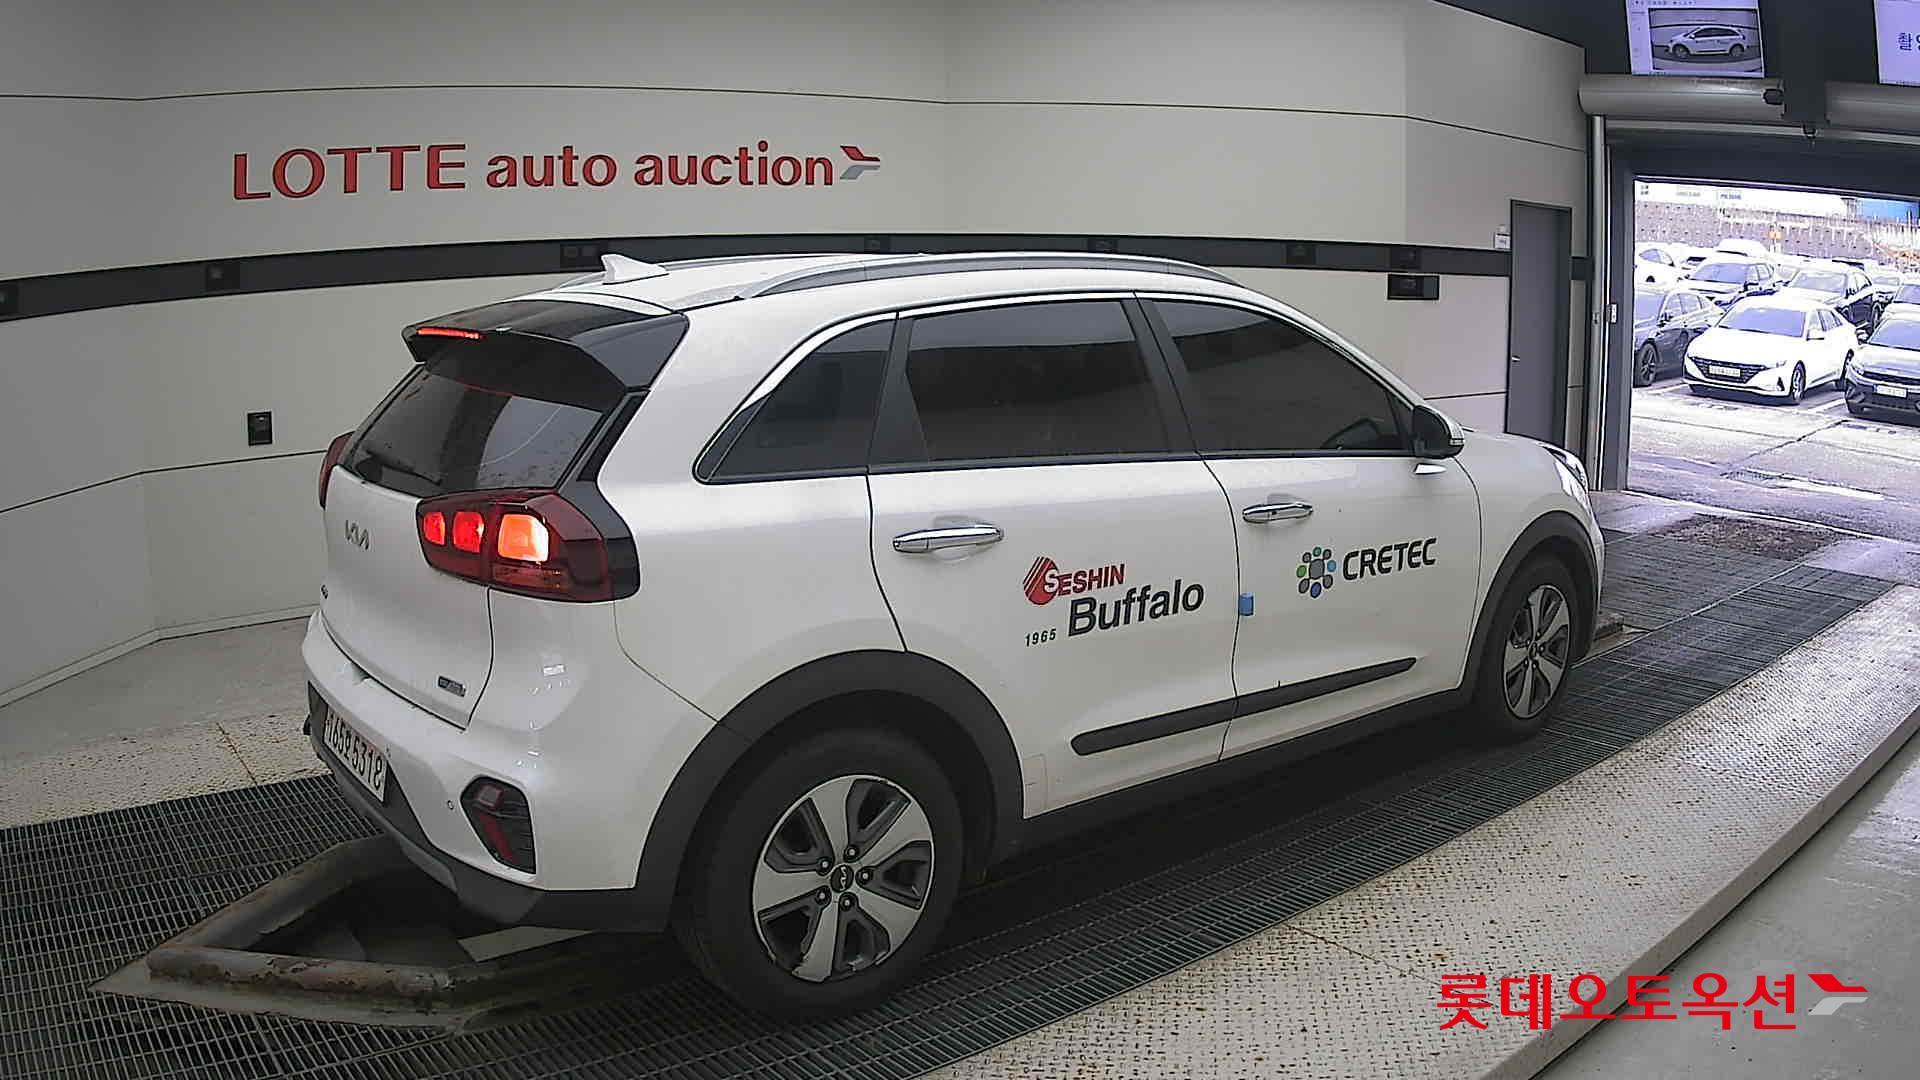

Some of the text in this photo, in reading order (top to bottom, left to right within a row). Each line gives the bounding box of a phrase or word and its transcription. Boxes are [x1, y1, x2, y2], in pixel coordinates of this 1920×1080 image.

[234, 140, 834, 200] LOTTE auto auction
[1044, 564, 1126, 597] SESHIN
[1342, 537, 1437, 581] CRETEC
[1068, 579, 1205, 637] Buffalo
[1025, 628, 1057, 647] 1965
[352, 735, 383, 791] 5318
